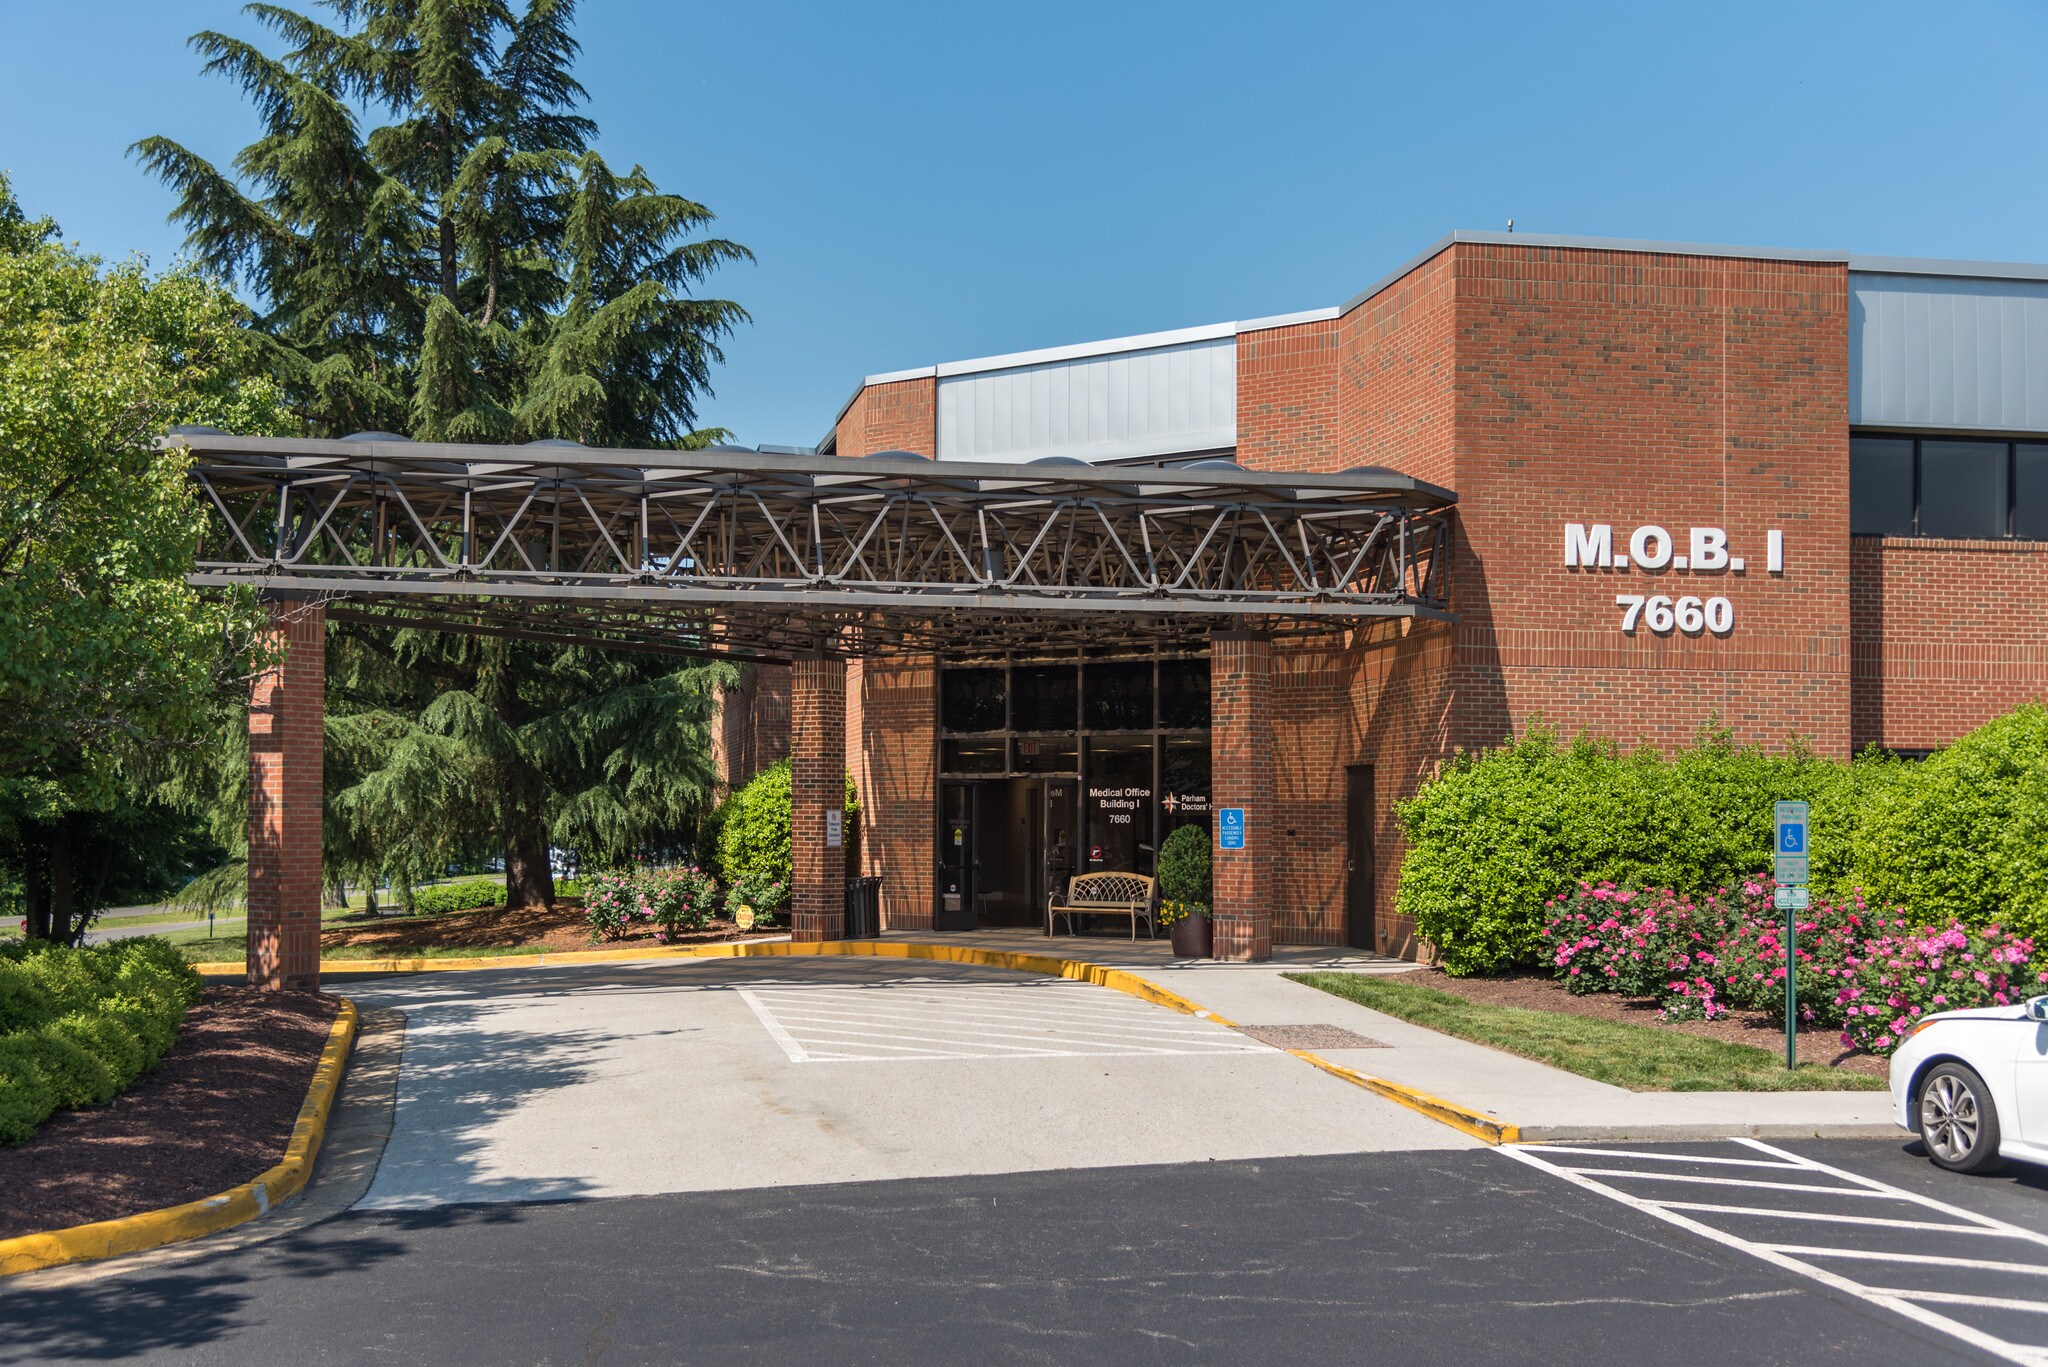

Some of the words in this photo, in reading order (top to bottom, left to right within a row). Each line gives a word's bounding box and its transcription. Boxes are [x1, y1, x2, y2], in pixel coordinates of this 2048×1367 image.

[1564, 523, 1745, 571] M.O.B.
[1767, 529, 1783, 572] I
[1616, 595, 1733, 633] 7660
[1089, 788, 1123, 797] Medical
[1124, 788, 1151, 797] Office
[1181, 794, 1206, 802] Parham
[1100, 799, 1135, 809] Building
[1136, 799, 1140, 808] I
[1181, 803, 1208, 811] Doctors'
[1109, 814, 1131, 824] 7660
